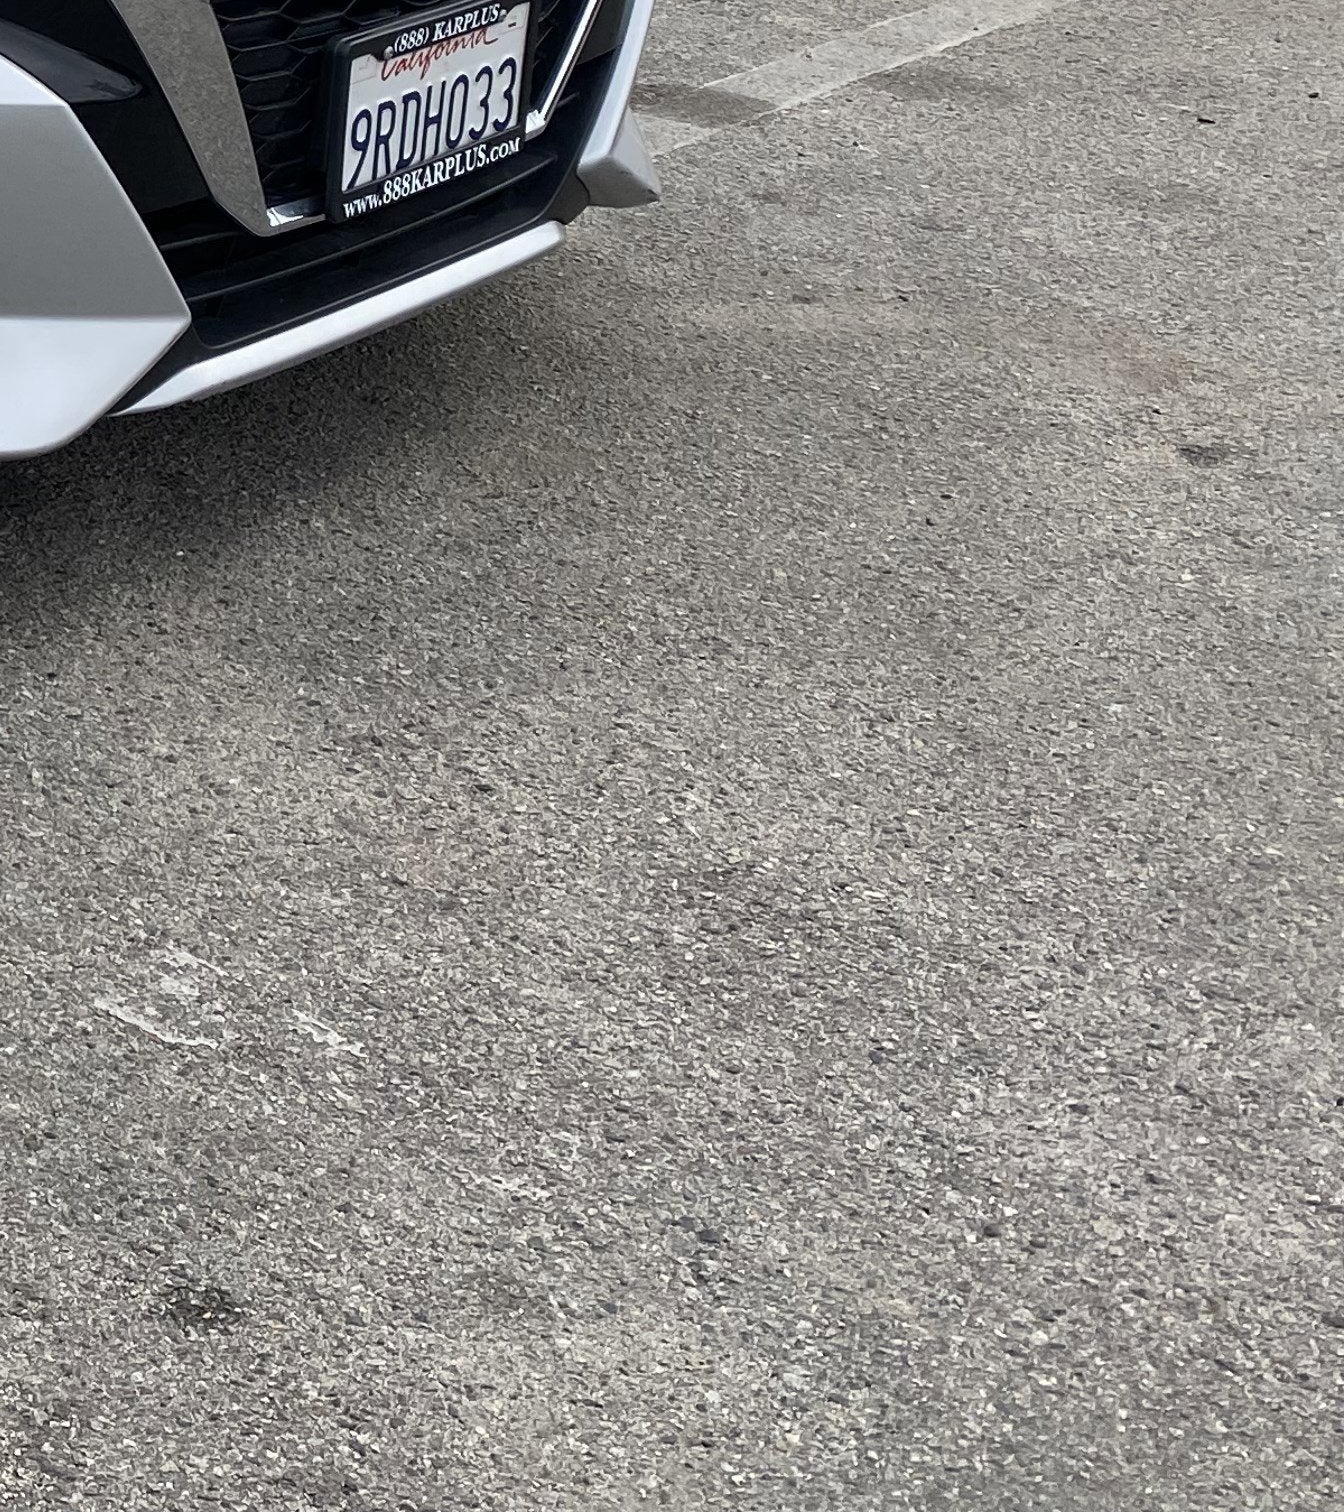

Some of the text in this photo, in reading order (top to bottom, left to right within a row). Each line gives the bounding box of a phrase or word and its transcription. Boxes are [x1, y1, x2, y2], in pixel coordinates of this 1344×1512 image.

[394, 26, 431, 53] (888)
[431, 2, 500, 42] KARPLUS
[346, 56, 517, 189] 9RDH033
